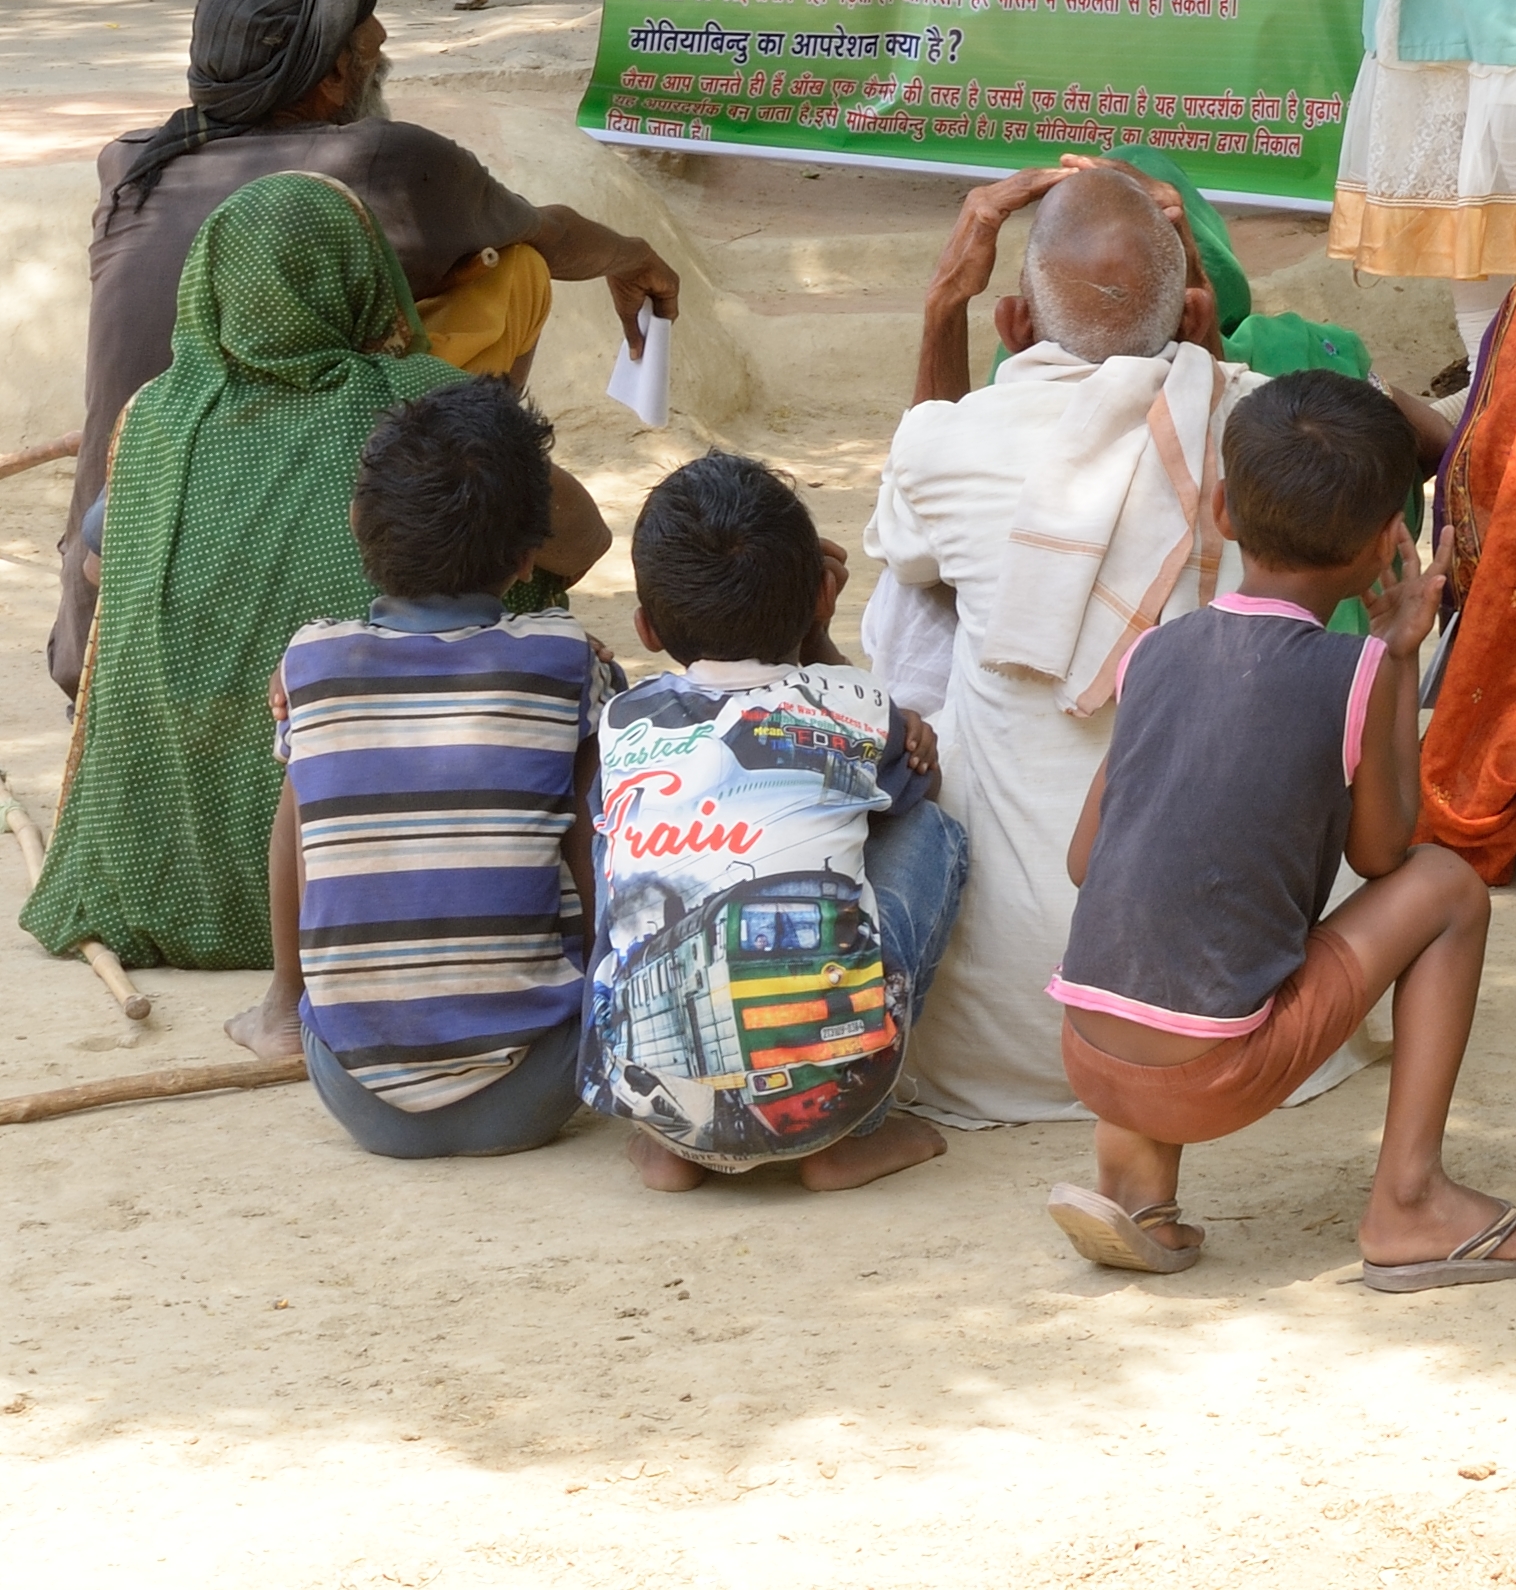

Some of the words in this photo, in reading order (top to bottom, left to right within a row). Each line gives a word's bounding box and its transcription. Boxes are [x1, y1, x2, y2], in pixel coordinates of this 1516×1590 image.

[630, 20, 751, 63] मोतियाबिन्दु
[757, 33, 786, 54] का
[791, 25, 880, 57] आपरेशन
[885, 34, 921, 58] क्या
[598, 771, 763, 876] Train
